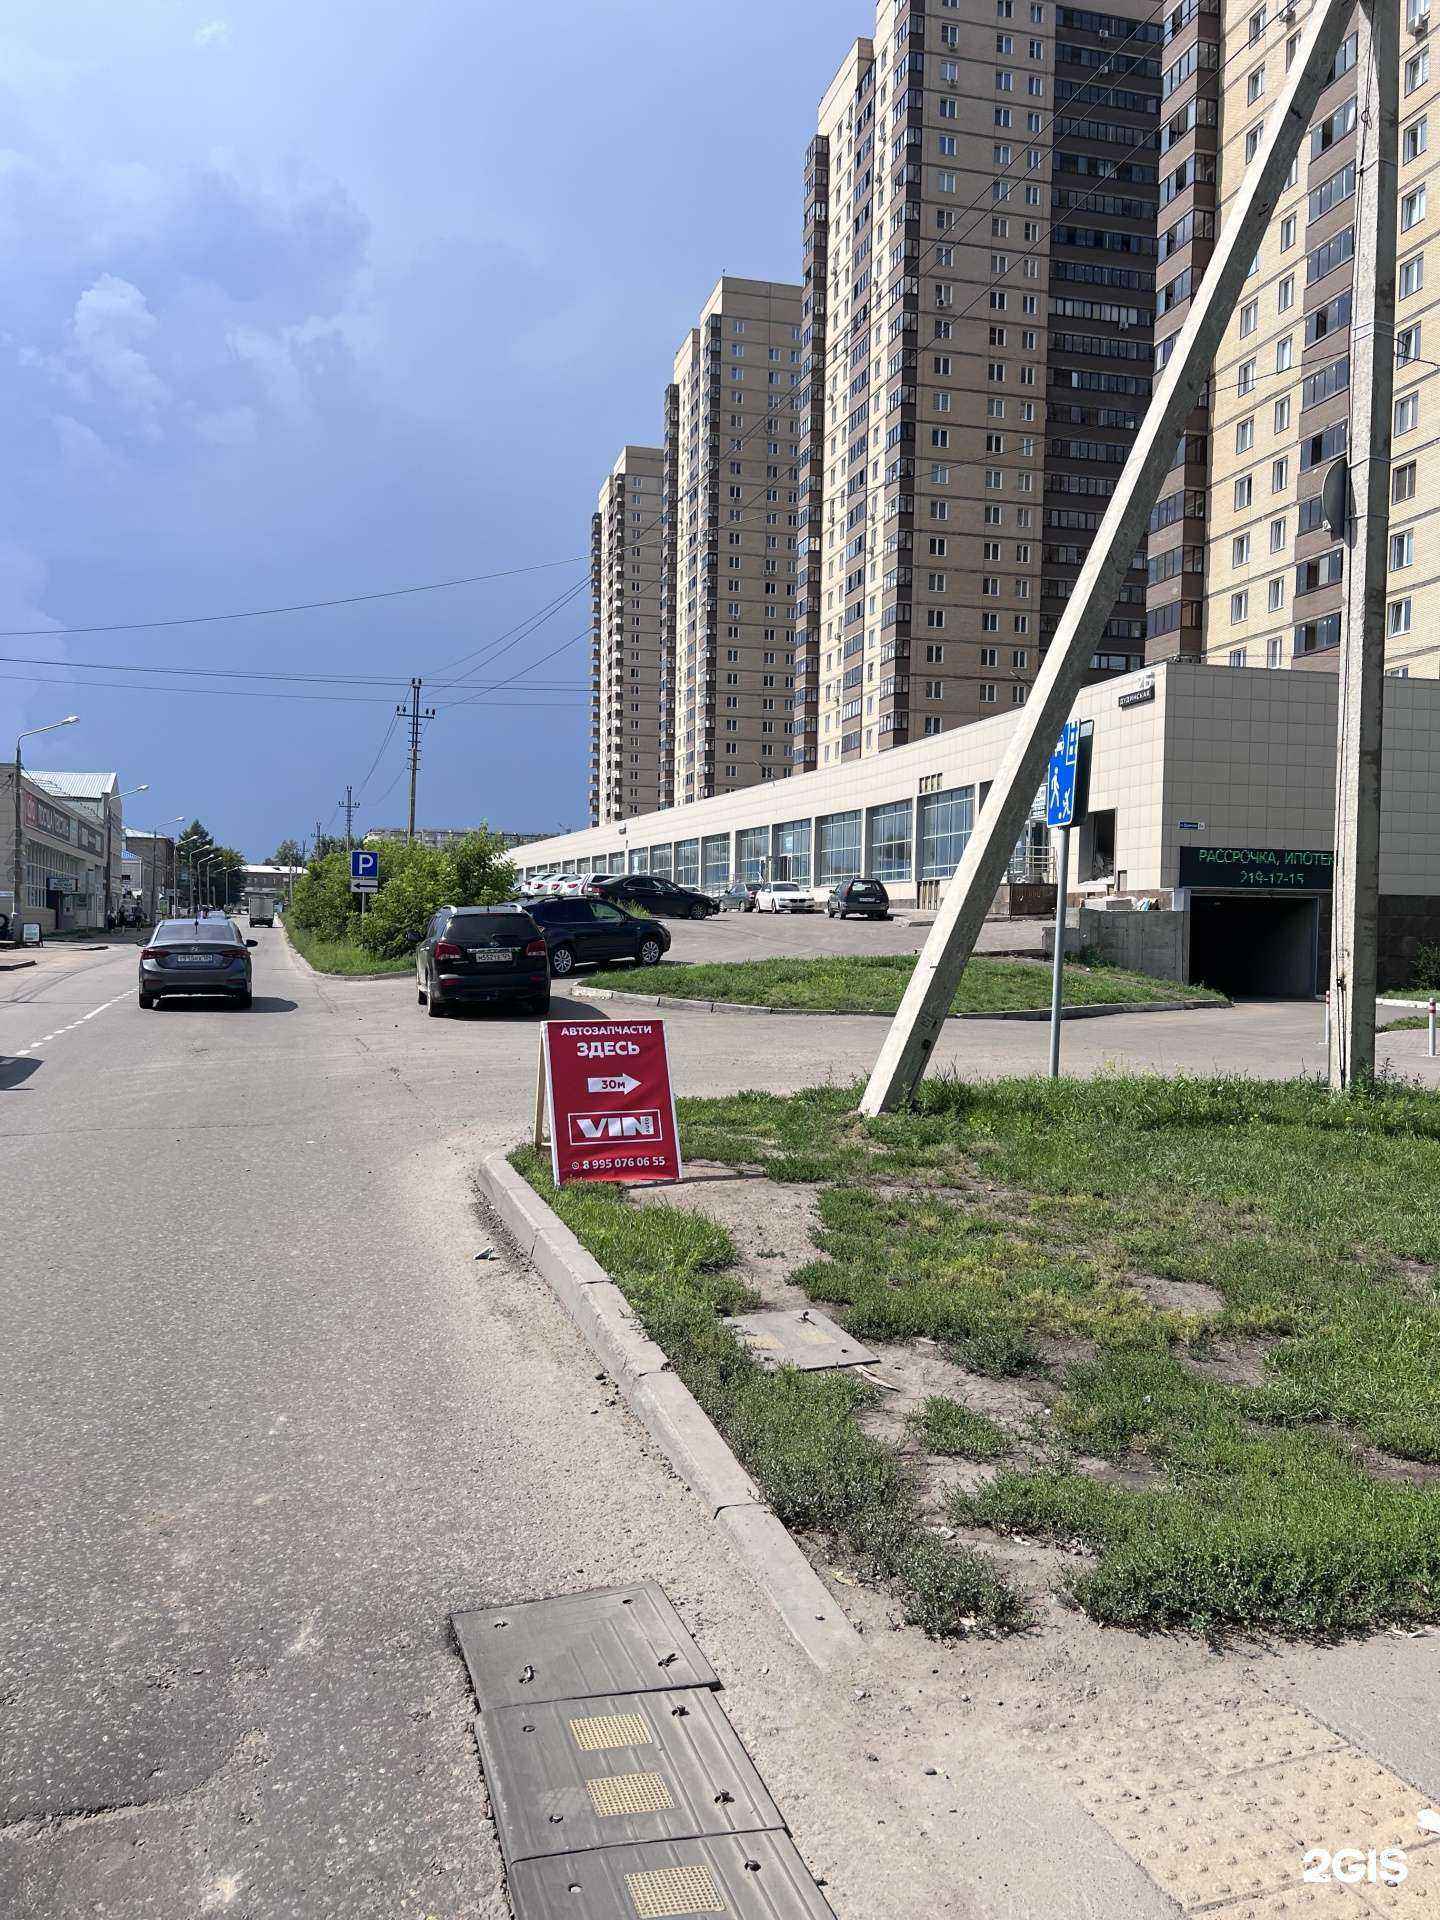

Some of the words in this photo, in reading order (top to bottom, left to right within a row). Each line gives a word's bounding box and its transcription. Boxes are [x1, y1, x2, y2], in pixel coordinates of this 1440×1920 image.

[358, 854, 374, 875] P
[1199, 849, 1280, 865] РАССРОЧКА,
[561, 1025, 652, 1036] АВТОЗАПЧАСТИ
[576, 1041, 640, 1058] ЗДЕСЬ
[576, 1115, 655, 1138] VIN
[582, 1161, 590, 1169] 8
[593, 1159, 612, 1169] 995
[615, 1158, 634, 1168] 076
[637, 1157, 650, 1167] 06
[652, 1156, 666, 1166] 55
